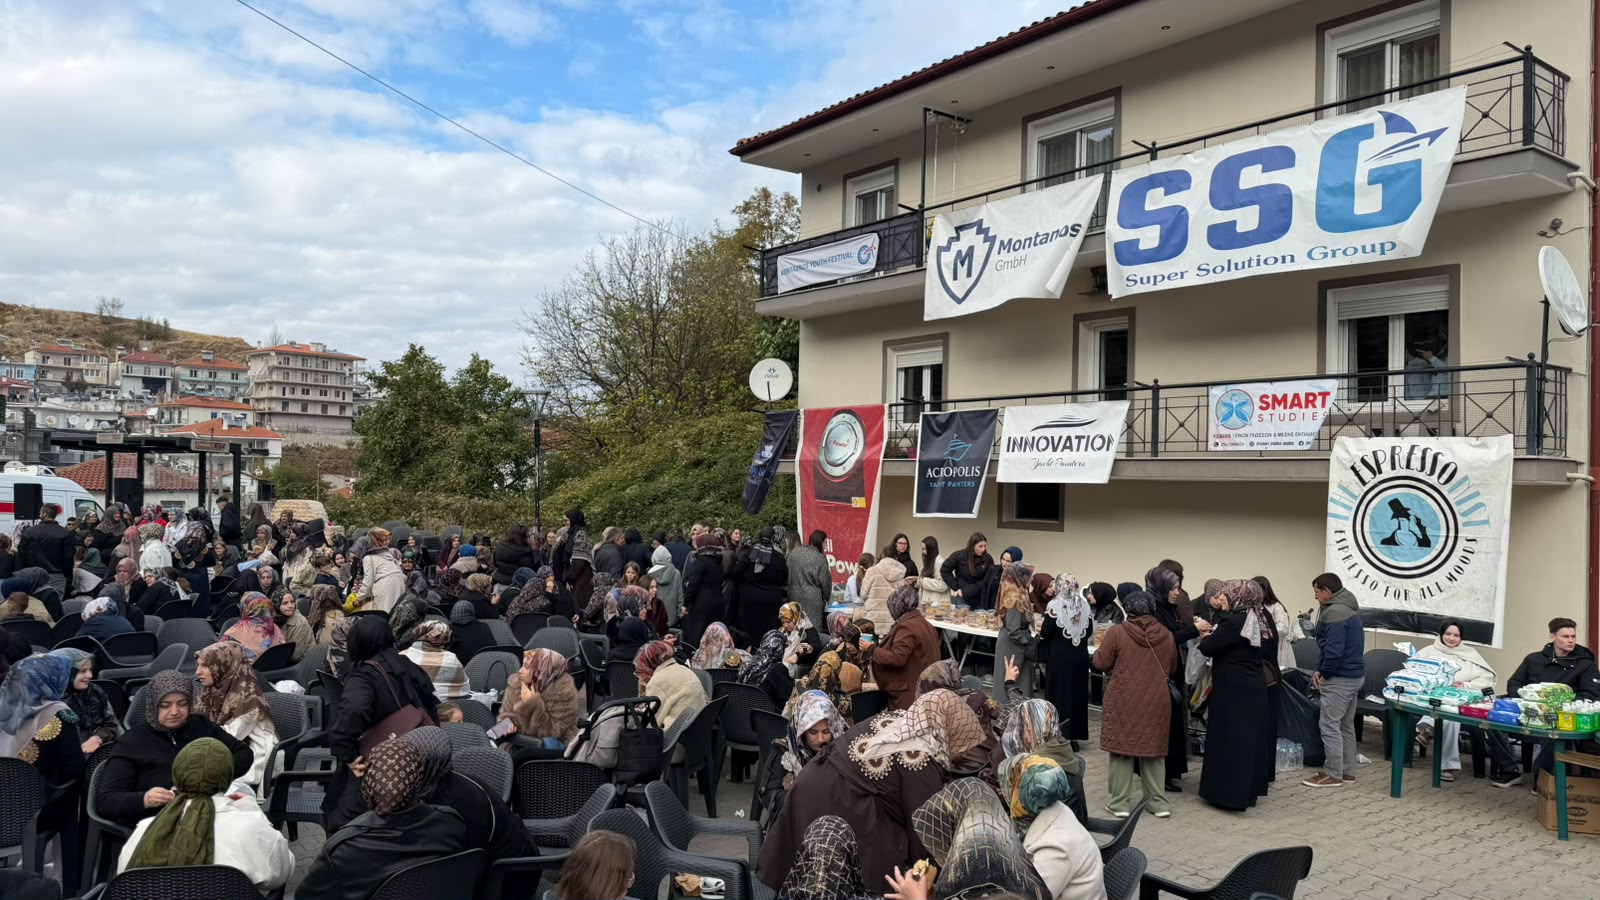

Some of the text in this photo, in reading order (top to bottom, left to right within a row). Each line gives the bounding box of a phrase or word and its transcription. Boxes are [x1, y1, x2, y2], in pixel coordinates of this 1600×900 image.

[1113, 121, 1424, 267] SSG
[996, 223, 1082, 256] Montanos
[809, 257, 828, 269] YOUTH
[827, 251, 854, 263] FESTIVAL
[952, 245, 975, 282] M
[994, 254, 1028, 272] GmbH
[1125, 238, 1398, 288] Super Solution Group
[1258, 391, 1331, 411] SMART
[1006, 433, 1115, 453] INNOVATION
[1030, 457, 1086, 470] Yacht Painters
[1334, 530, 1479, 601] ESPRESSO FOR ALL MOODS
